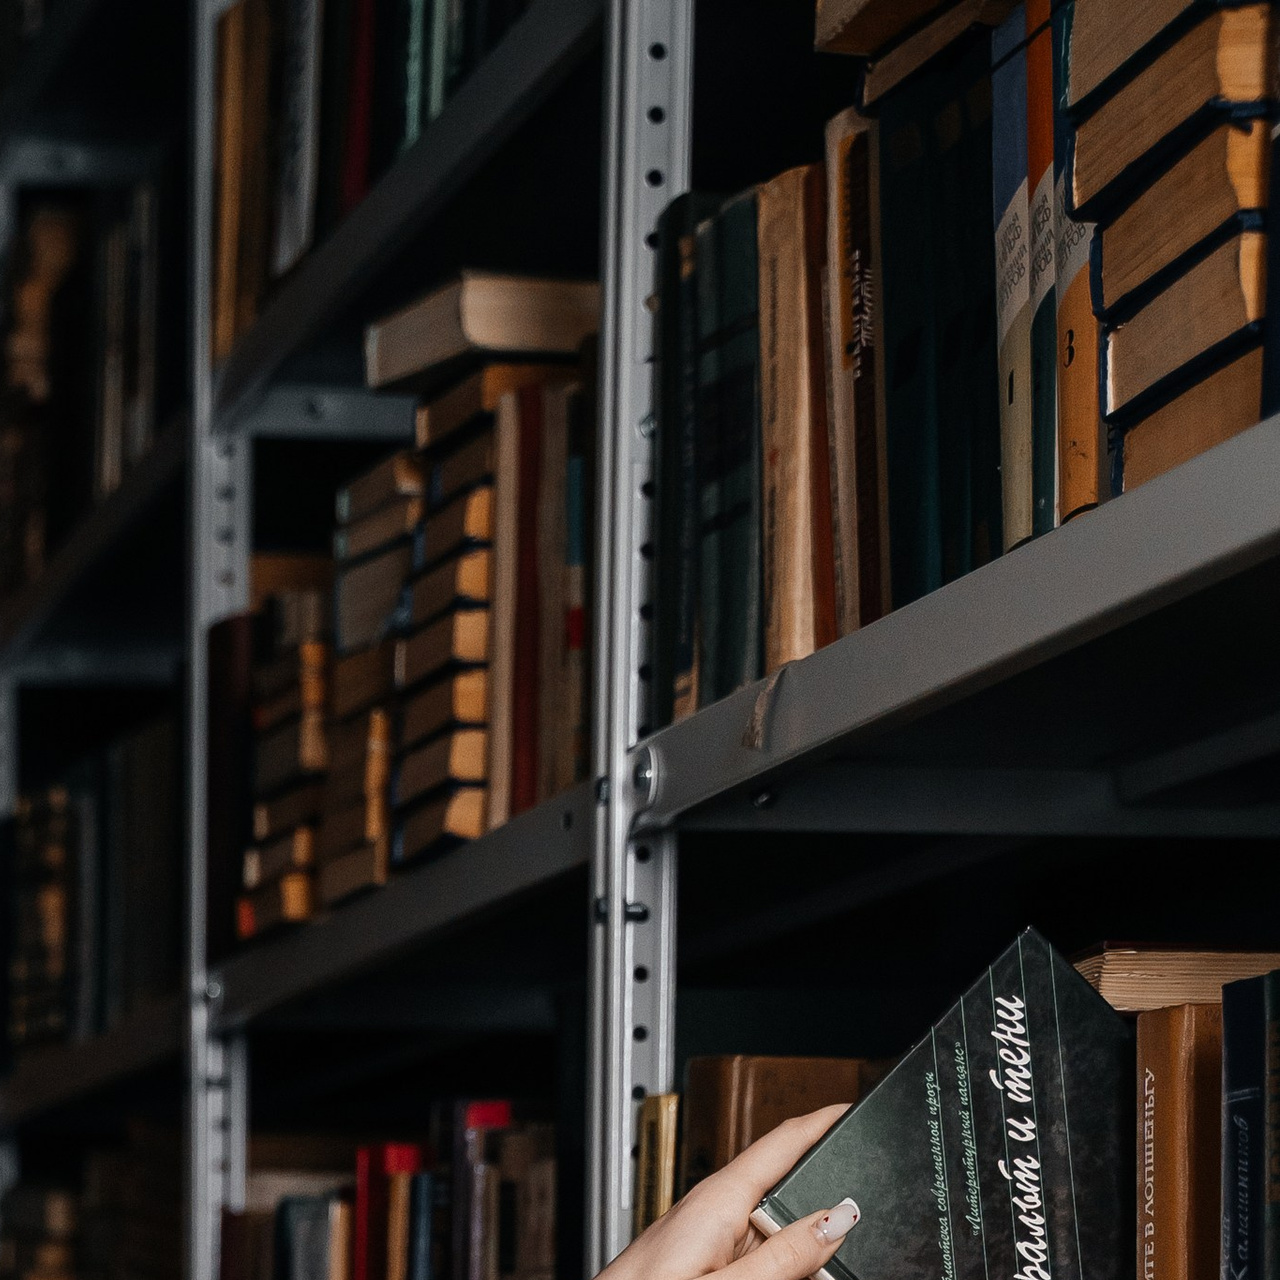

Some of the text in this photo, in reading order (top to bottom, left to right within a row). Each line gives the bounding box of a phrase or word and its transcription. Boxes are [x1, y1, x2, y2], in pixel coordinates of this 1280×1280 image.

[1063, 329, 1075, 368] 3
[989, 992, 1033, 1105] тени
[926, 1071, 942, 1118] прозы
[1006, 1115, 1038, 1142] и
[930, 1121, 950, 1213] современной
[959, 1111, 982, 1237] «Литературный
[1143, 1068, 1156, 1217] ЛОПШЕНЬГУ
[1144, 1221, 1155, 1236] В
